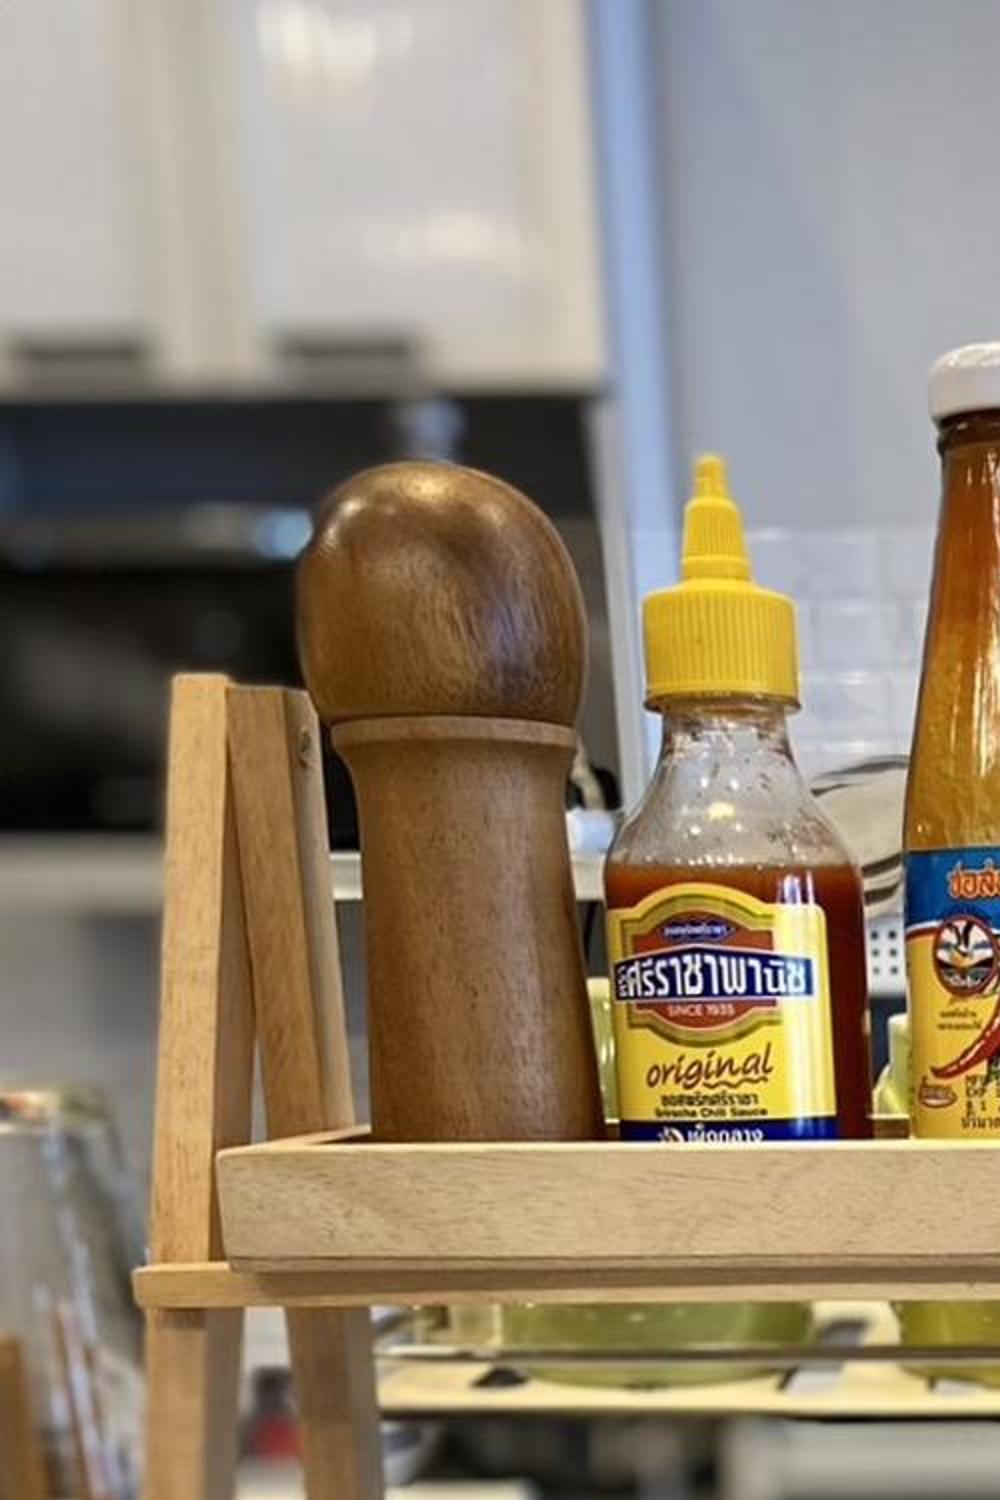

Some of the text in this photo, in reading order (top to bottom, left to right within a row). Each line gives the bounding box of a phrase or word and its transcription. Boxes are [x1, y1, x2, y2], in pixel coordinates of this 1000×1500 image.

[626, 953, 806, 998] ศรีราชาพานิช
[667, 1004, 703, 1016] SINCE
[645, 1042, 774, 1089] original
